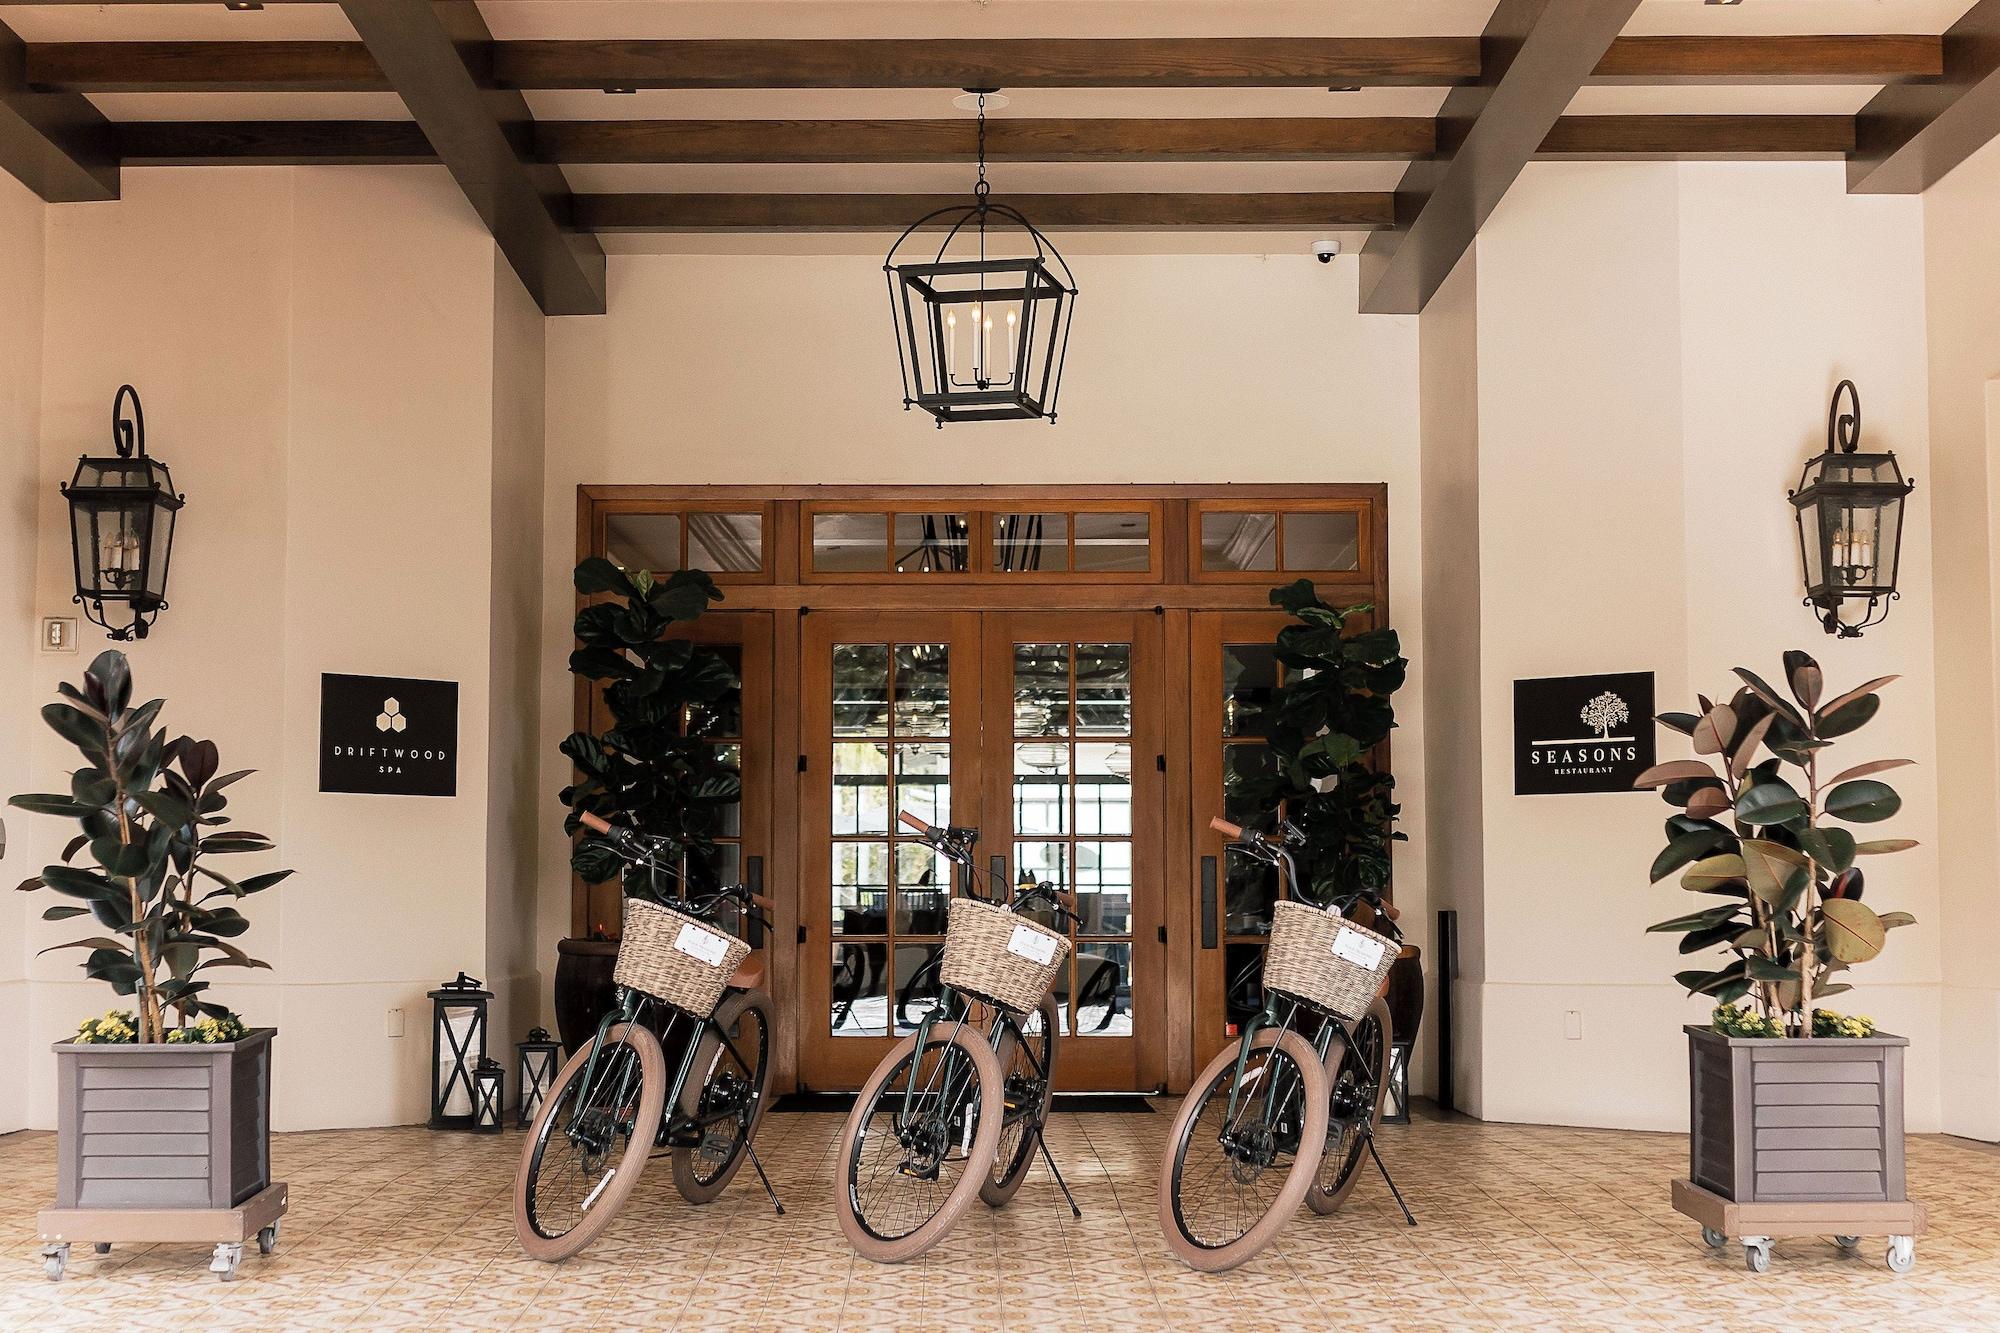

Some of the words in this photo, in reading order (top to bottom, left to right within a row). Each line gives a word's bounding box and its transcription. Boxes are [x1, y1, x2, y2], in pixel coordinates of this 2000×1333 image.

[334, 746, 446, 760] DRIFTWOOD
[1531, 746, 1636, 764] SEASONS
[378, 766, 402, 774] SPA
[1554, 766, 1614, 775] RESTAURANT
